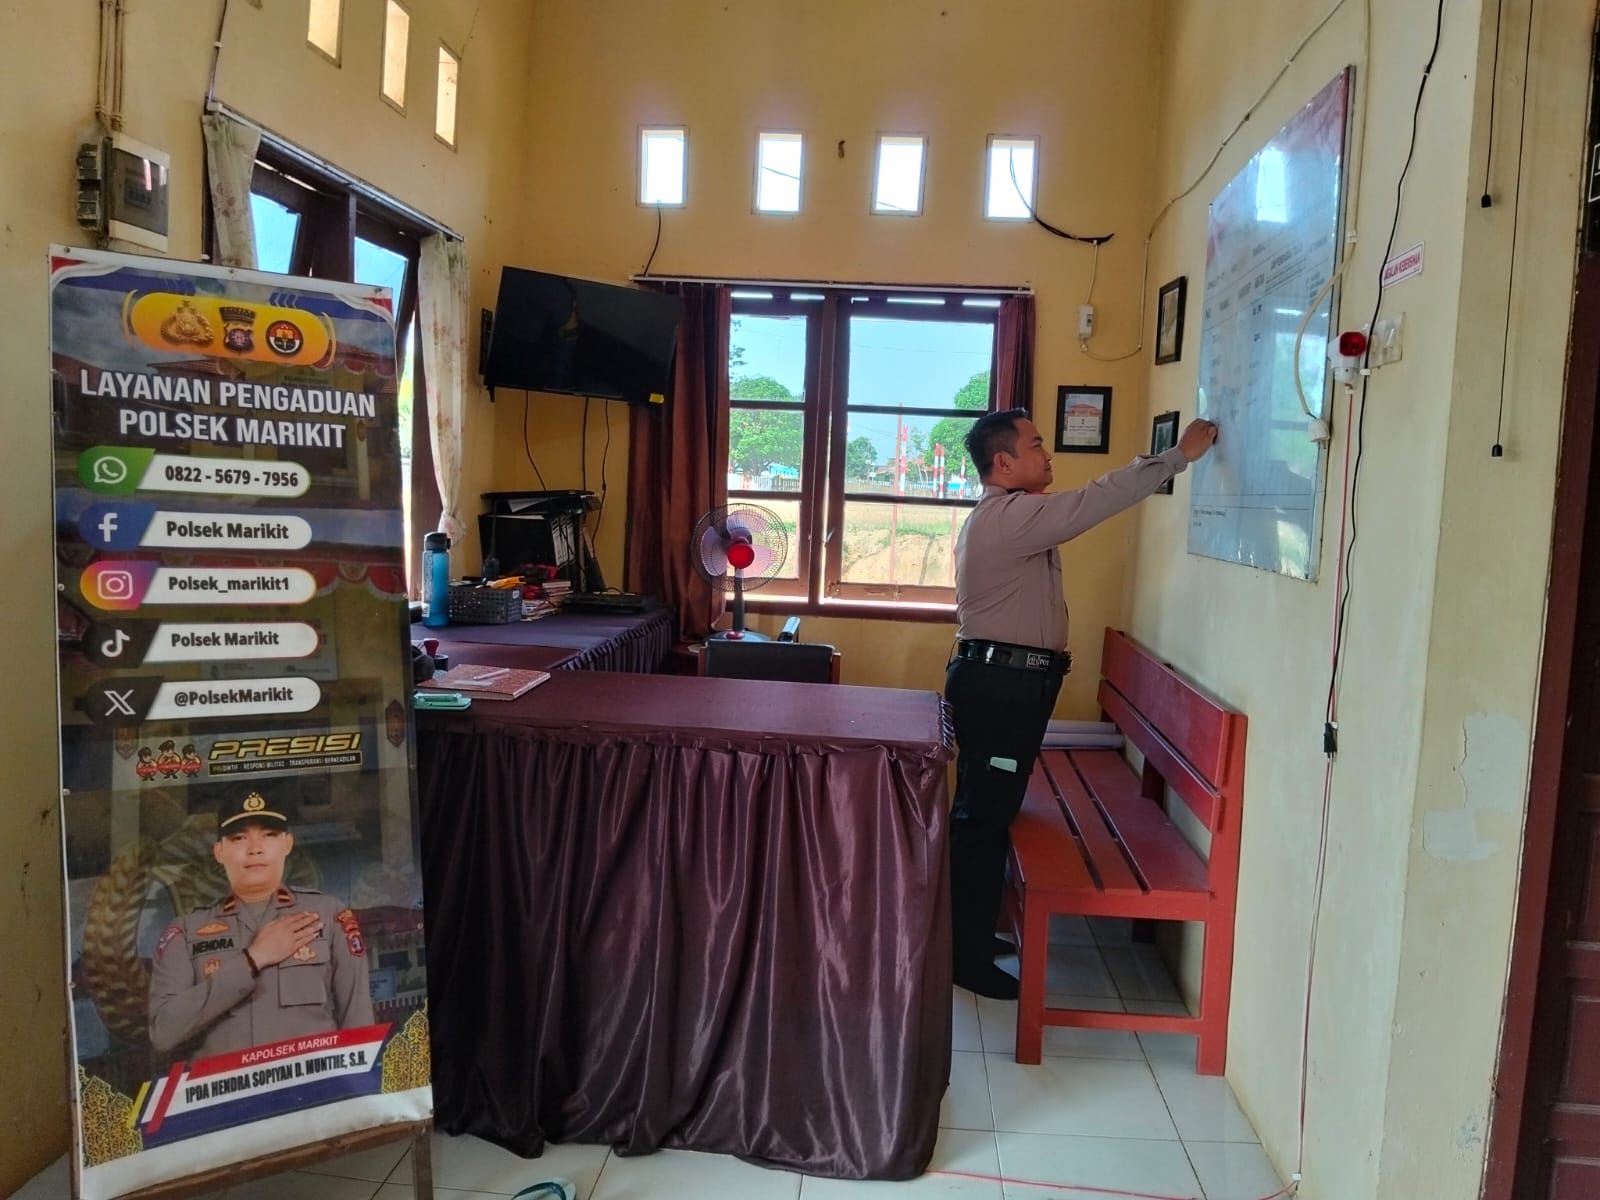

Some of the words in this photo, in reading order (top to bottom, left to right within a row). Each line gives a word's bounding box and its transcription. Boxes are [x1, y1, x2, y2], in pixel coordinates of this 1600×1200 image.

[80, 369, 212, 405] LAYANAN
[220, 383, 376, 418] PENGADUAN
[120, 409, 229, 442] POLSEK
[236, 419, 346, 448] MARIKIT
[165, 465, 202, 482] 0822
[215, 467, 250, 485] 5679
[263, 470, 299, 488] 7956
[166, 521, 223, 539] Polsek
[226, 522, 289, 540] Marikit
[168, 576, 289, 594] Polsek_marikit1
[171, 632, 221, 648] Polsek
[224, 631, 279, 646] Marikit
[174, 687, 293, 707] @PolsekMarikit
[208, 733, 361, 760] PRESISI
[192, 938, 234, 955] HENDRA
[241, 1042, 295, 1065] KAPOLSEK
[296, 1035, 339, 1054] MARIKIT
[186, 1082, 209, 1104] IPDA
[211, 1075, 250, 1099] HENDRA
[252, 1067, 293, 1093] SOPIYAN
[295, 1063, 304, 1085] D.
[305, 1054, 347, 1083] MUNTHE,
[349, 1050, 368, 1067] S.H.
